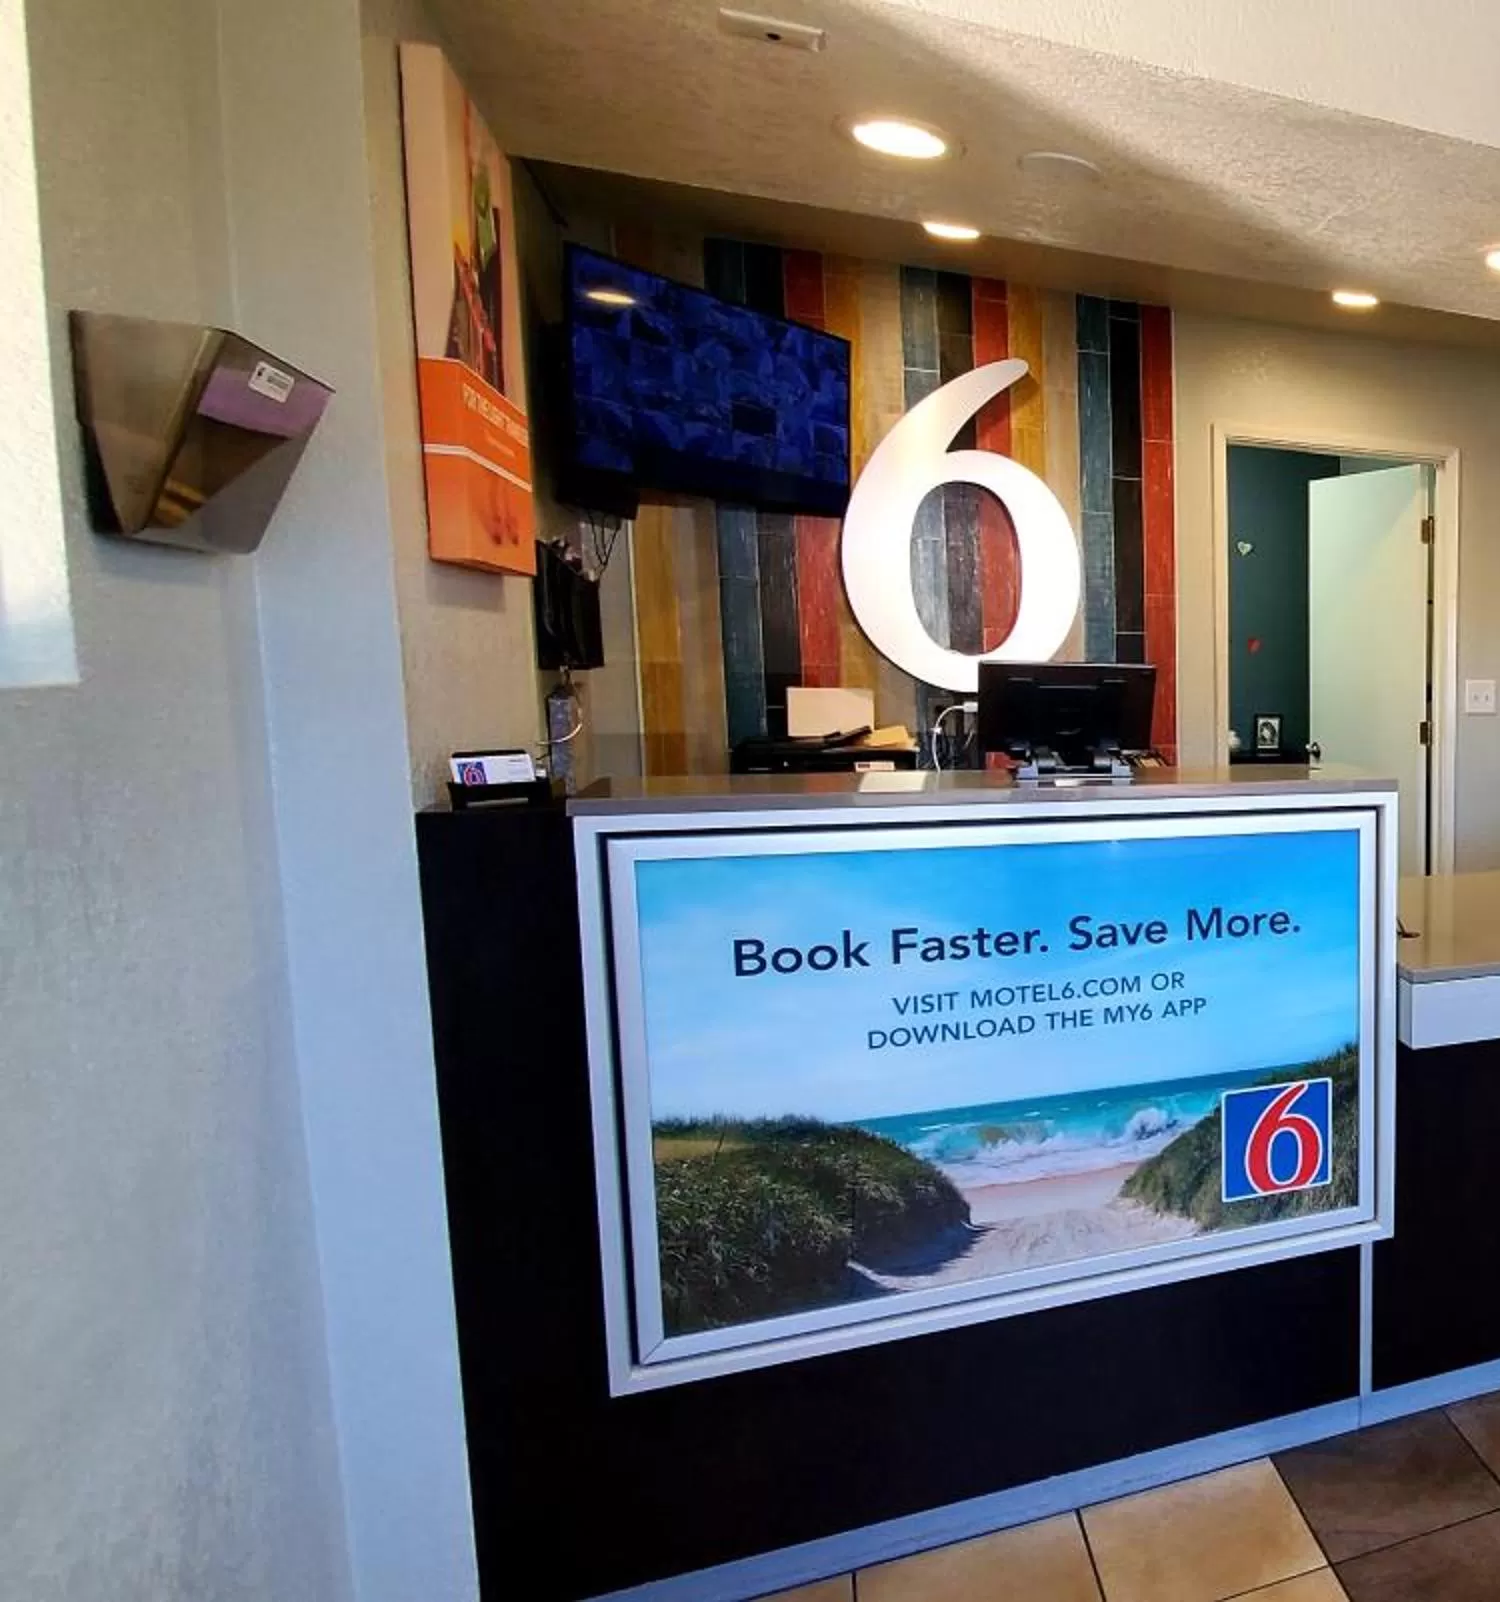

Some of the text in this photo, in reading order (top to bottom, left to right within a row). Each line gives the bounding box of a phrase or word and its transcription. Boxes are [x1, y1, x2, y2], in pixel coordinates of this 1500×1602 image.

[841, 357, 1082, 694] 6
[733, 906, 1300, 977] Book Faster. Save More.
[867, 997, 1207, 1050] DOWNLOAD THE MY6 APP
[892, 971, 1185, 1016] VISIT MOTEL6.COM OR
[1245, 1081, 1325, 1193] 6
